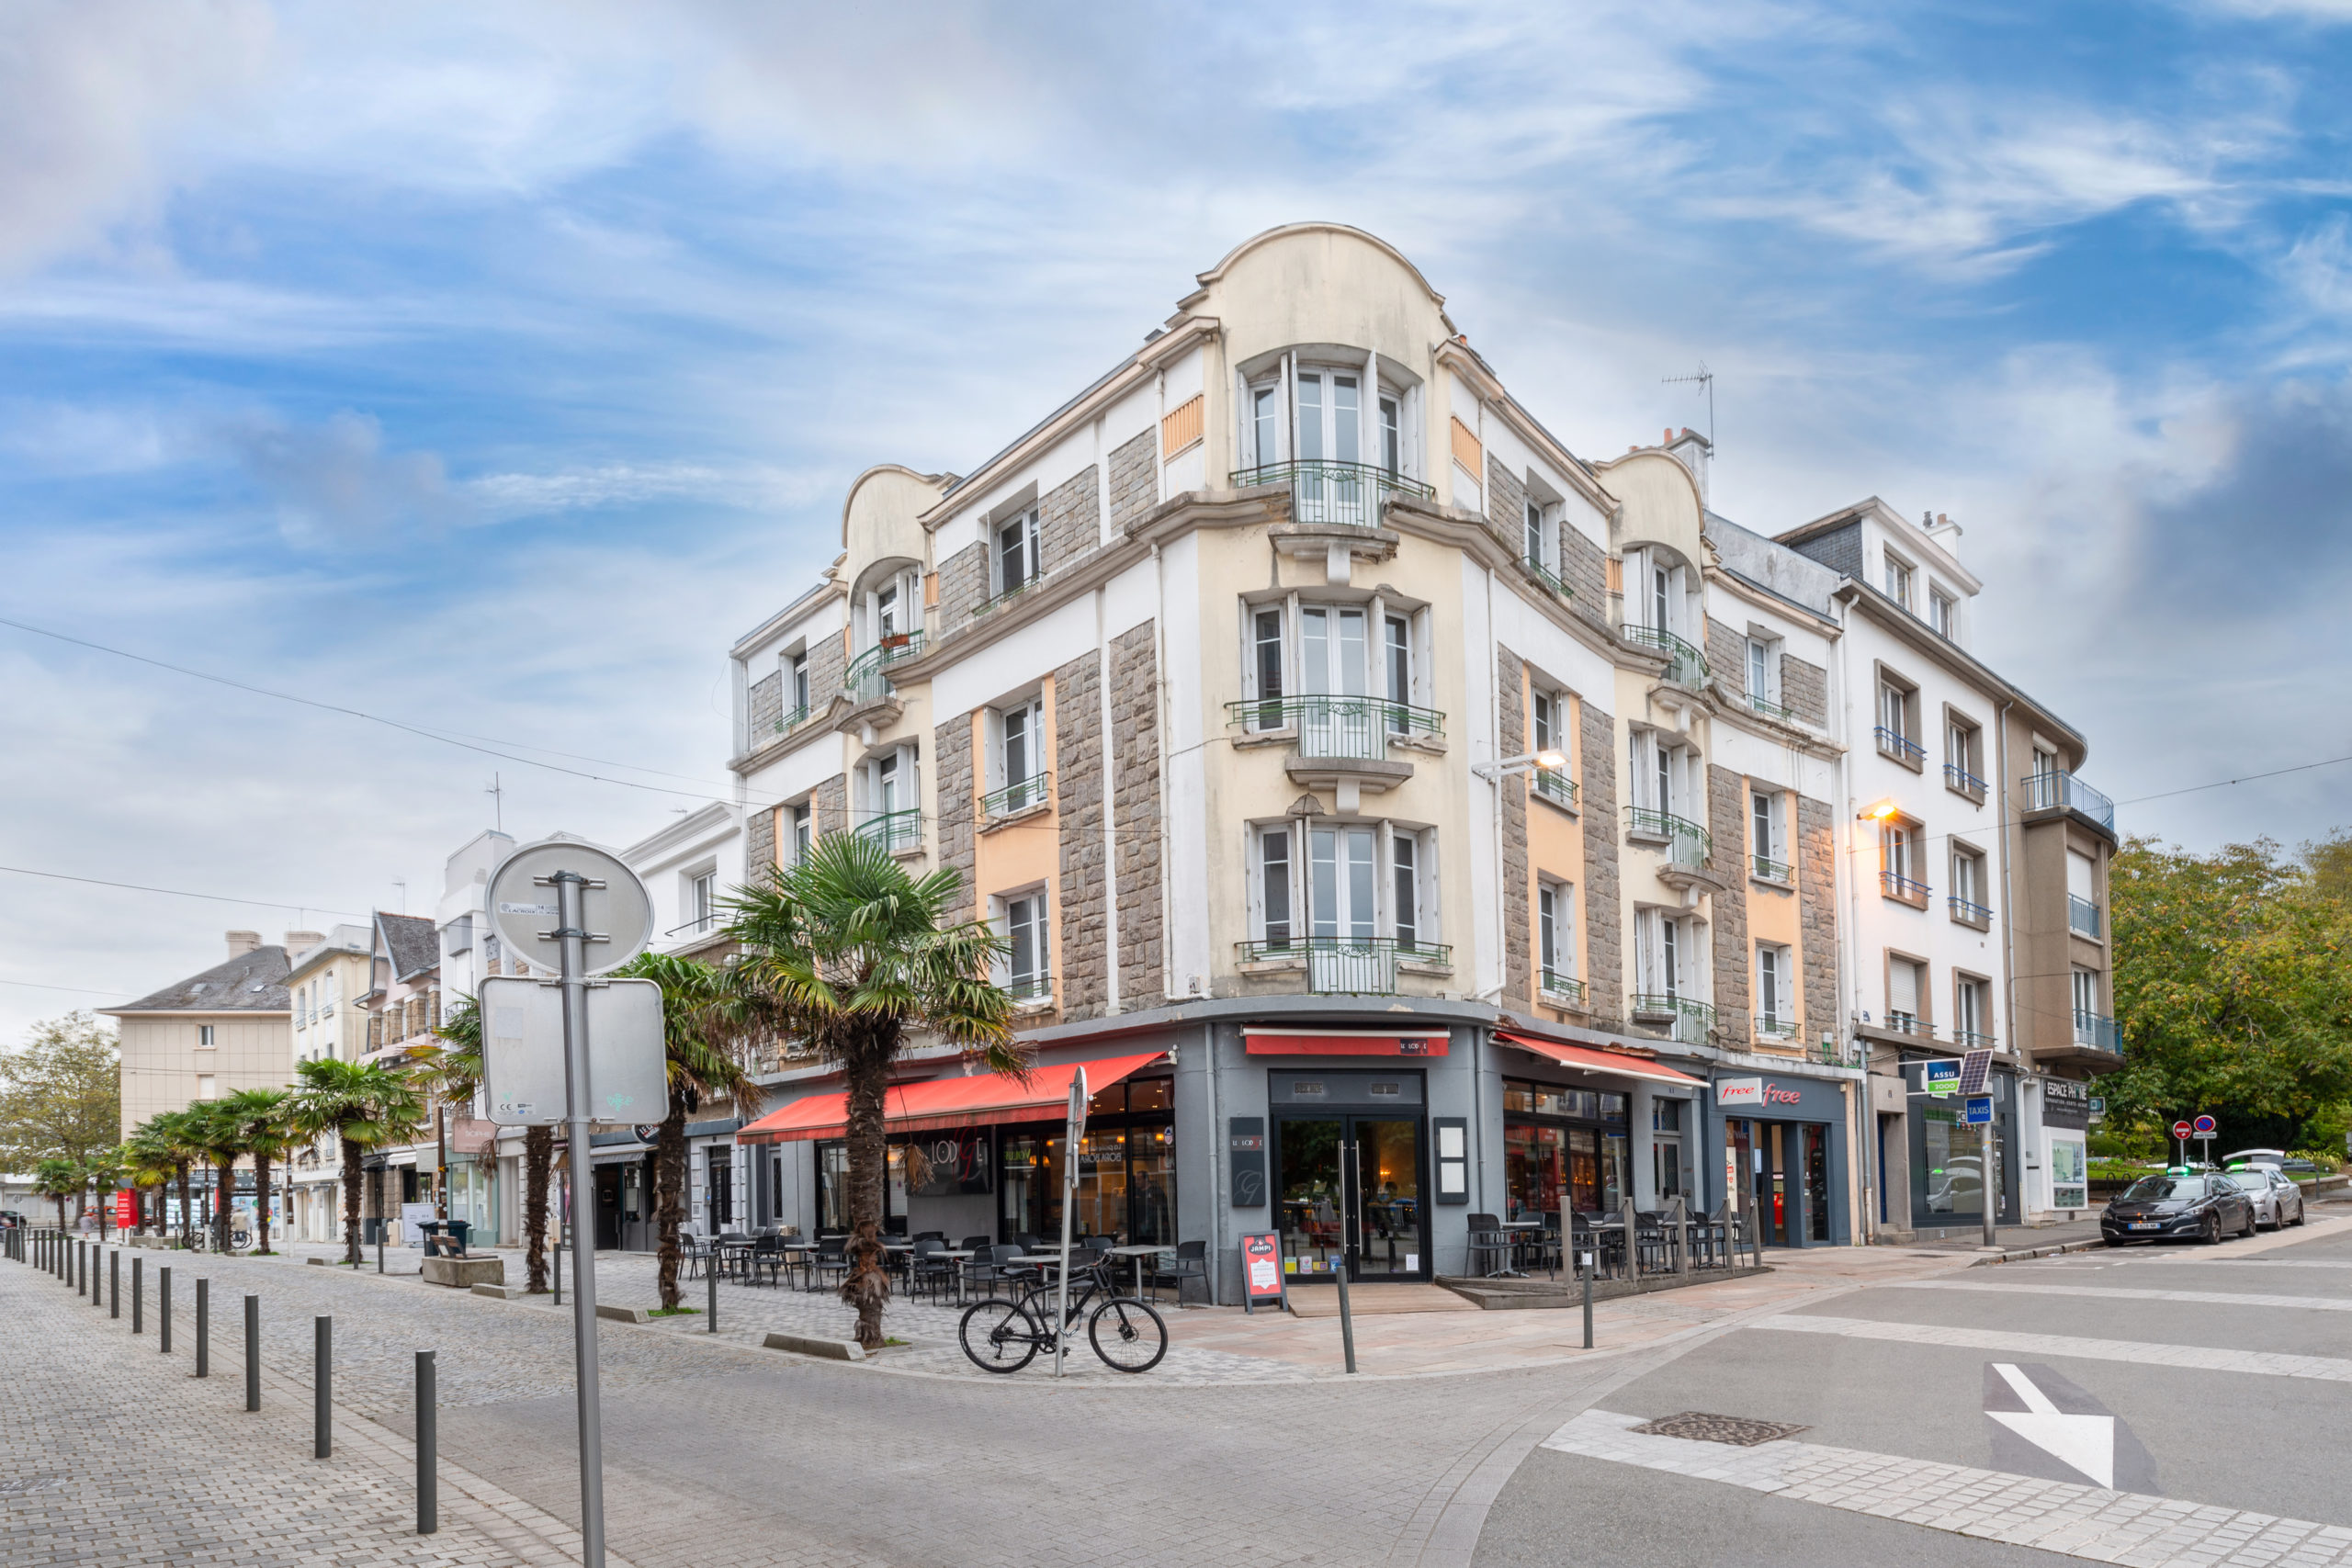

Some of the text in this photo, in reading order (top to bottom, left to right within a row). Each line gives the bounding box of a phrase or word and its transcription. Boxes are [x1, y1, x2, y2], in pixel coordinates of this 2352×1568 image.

[1722, 1085, 1755, 1100] free
[1761, 1083, 1801, 1107] free
[2047, 1081, 2067, 1098] ESPACE
[1969, 1105, 1989, 1116] TAXIS
